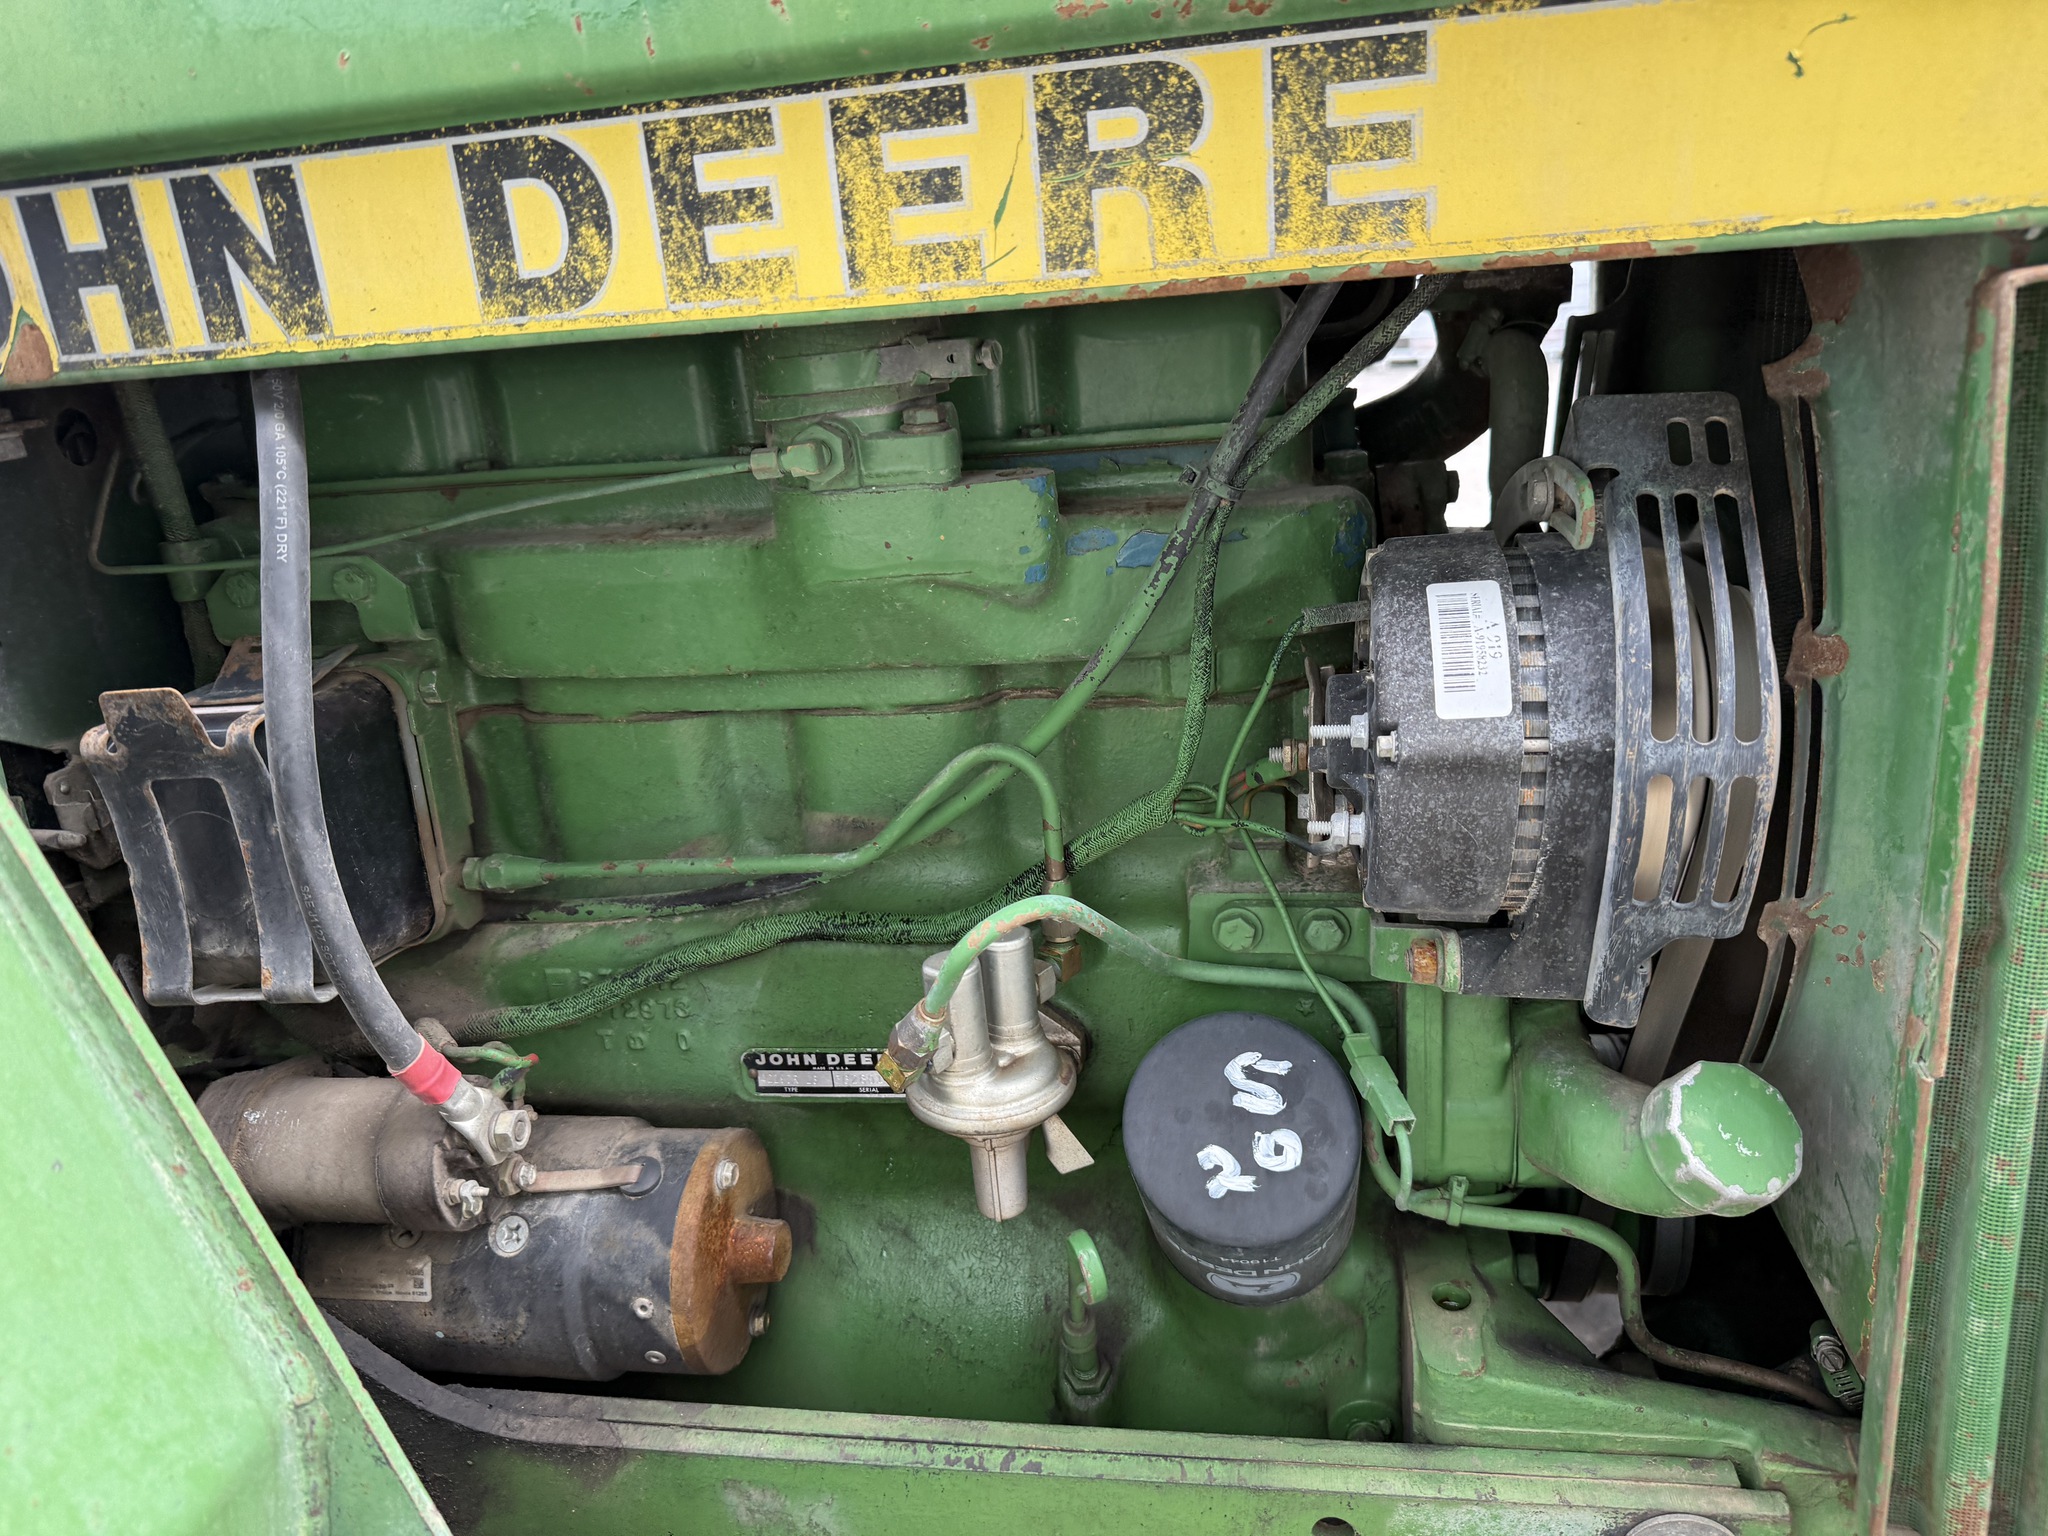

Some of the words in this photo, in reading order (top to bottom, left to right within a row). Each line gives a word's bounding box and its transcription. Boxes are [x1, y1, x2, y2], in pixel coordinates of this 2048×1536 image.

[448, 26, 1436, 323] DEERE
[274, 402, 285, 420] 2/0
[275, 422, 286, 440] GA
[275, 444, 287, 480] 105°C
[274, 484, 287, 530] (221°F)
[276, 533, 287, 564] DRY
[300, 886, 315, 910] SAE
[755, 1053, 818, 1066] JOHN
[826, 1053, 882, 1066] DEE
[1264, 1233, 1335, 1275] JOHN
